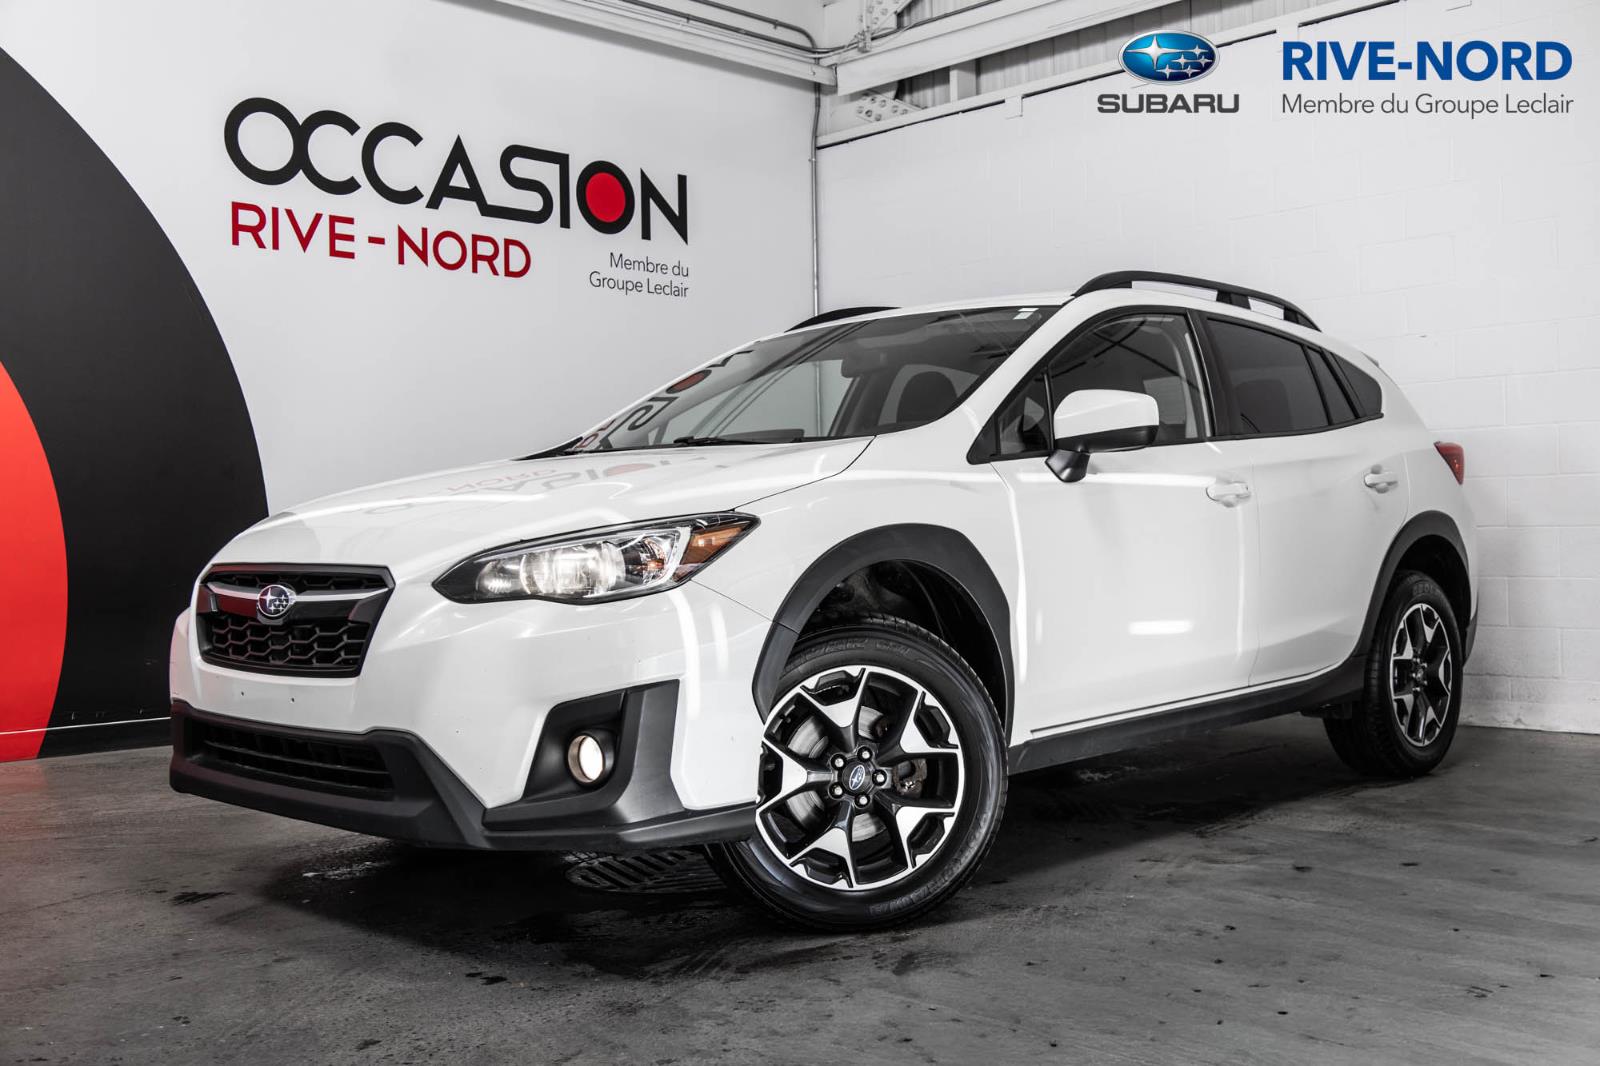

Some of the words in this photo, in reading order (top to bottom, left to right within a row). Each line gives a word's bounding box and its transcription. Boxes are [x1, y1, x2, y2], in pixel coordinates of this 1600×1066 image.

[224, 97, 689, 246] OCCASION
[609, 252, 669, 275] Membre
[671, 263, 689, 278] du
[589, 271, 643, 296] Groupe
[646, 278, 689, 298] Leclair
